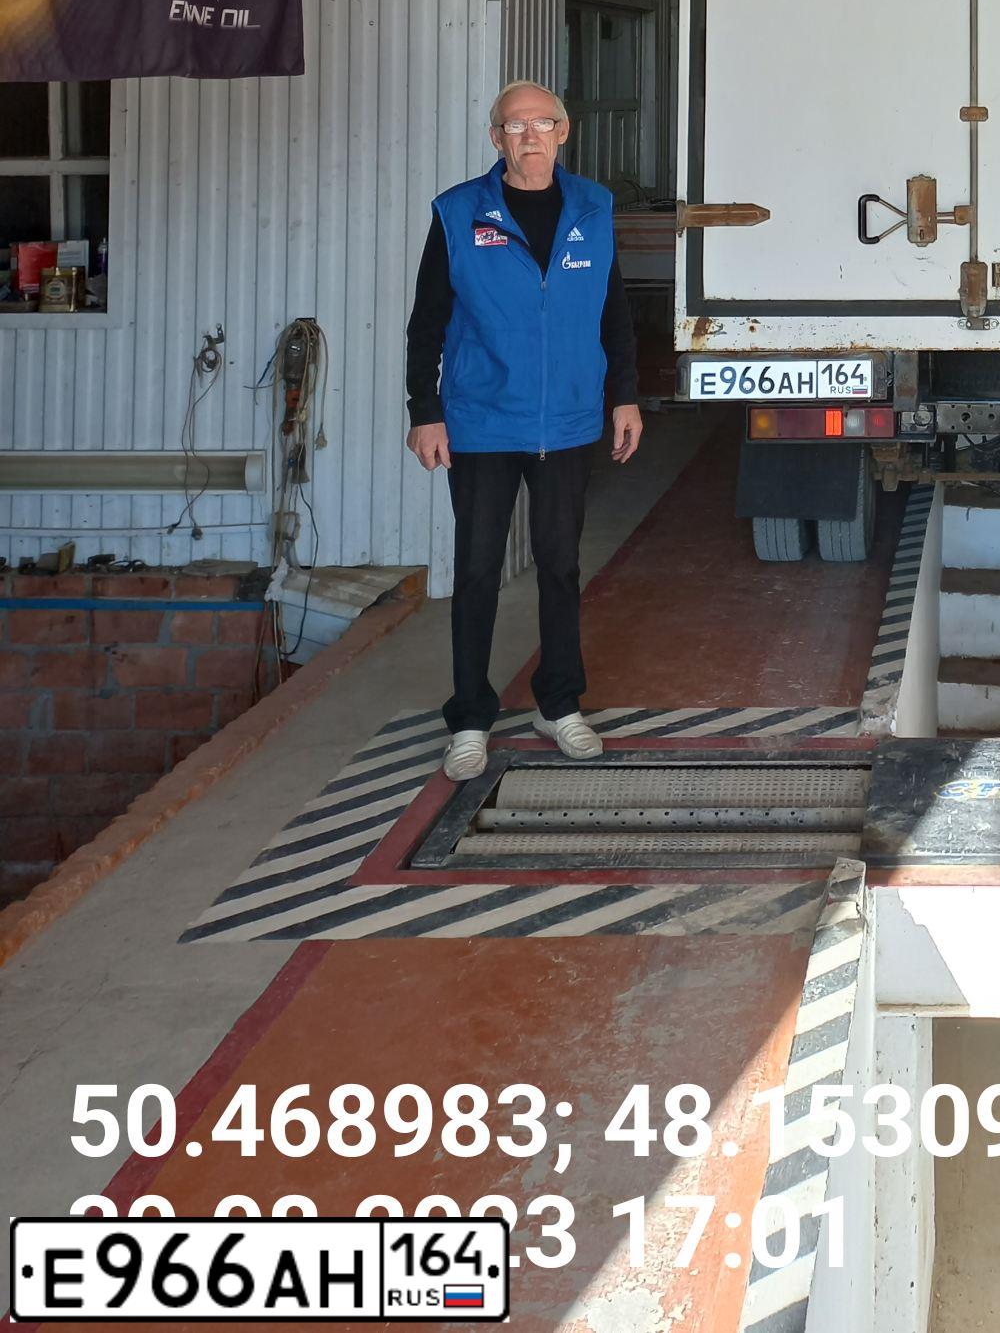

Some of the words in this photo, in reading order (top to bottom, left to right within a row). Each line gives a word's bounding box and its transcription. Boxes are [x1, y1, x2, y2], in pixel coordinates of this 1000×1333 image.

[221, 9, 260, 28] OIL
[821, 363, 864, 386] 164
[829, 386, 851, 395] RUS
